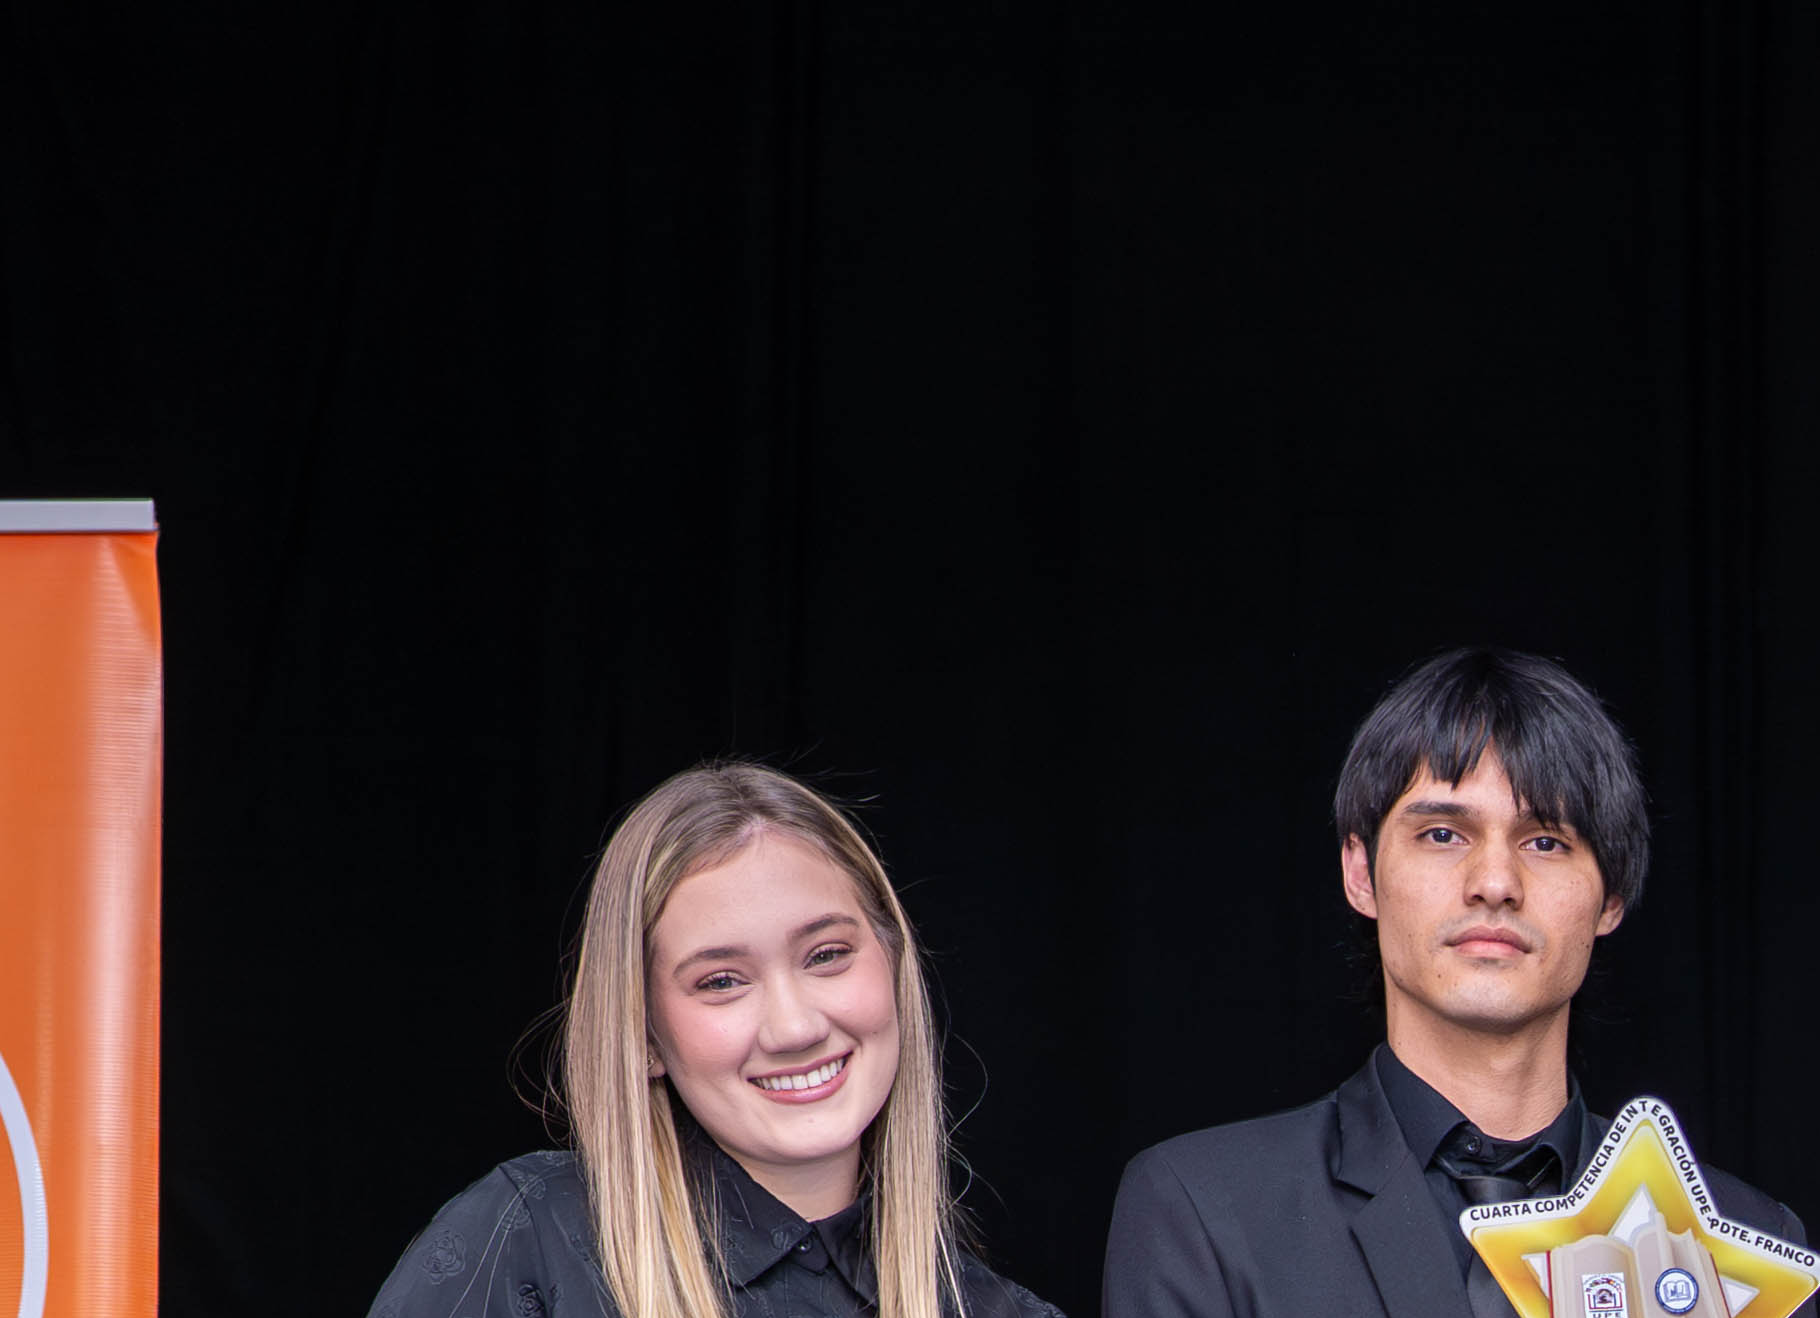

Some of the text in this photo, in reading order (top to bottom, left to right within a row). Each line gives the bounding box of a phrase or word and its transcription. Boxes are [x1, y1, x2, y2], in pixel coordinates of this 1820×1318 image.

[1470, 1203, 1532, 1221] CUARTA
[1535, 1144, 1615, 1213] COMPETENCIA
[1609, 1122, 1627, 1144] DE
[1754, 1236, 1815, 1267] FRANCO
